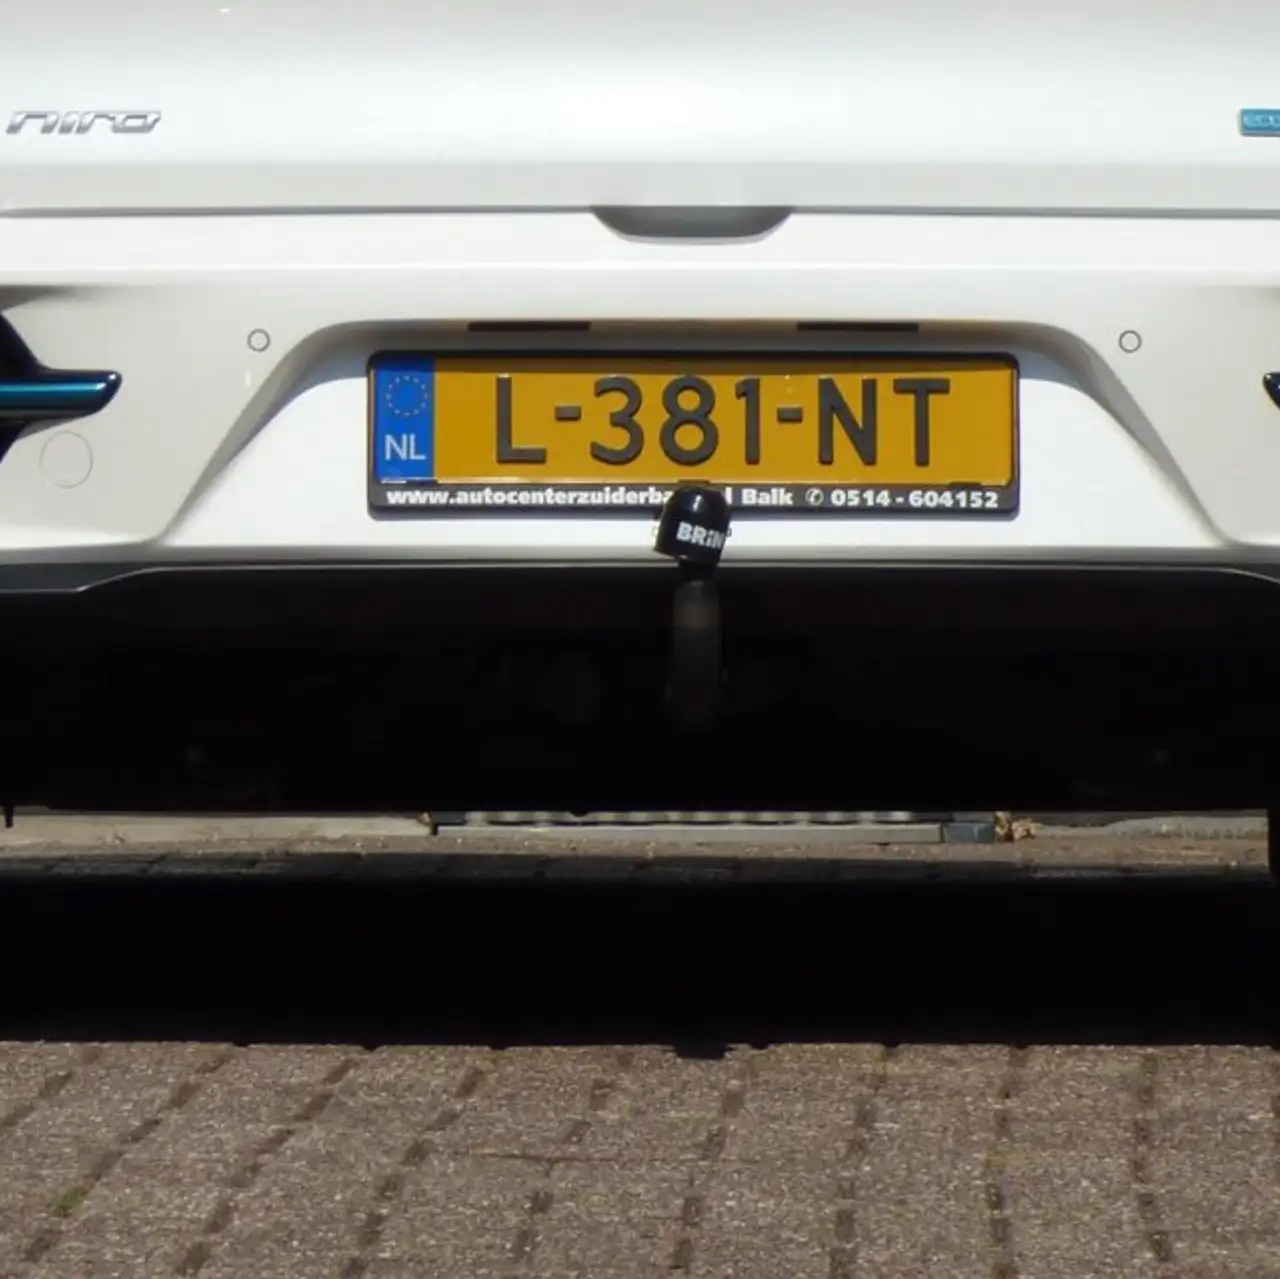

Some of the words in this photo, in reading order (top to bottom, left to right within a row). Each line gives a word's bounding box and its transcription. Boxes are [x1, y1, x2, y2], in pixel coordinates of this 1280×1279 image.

[495, 375, 951, 468] L-381-NT
[384, 434, 426, 461] NL
[741, 488, 793, 506] Balk
